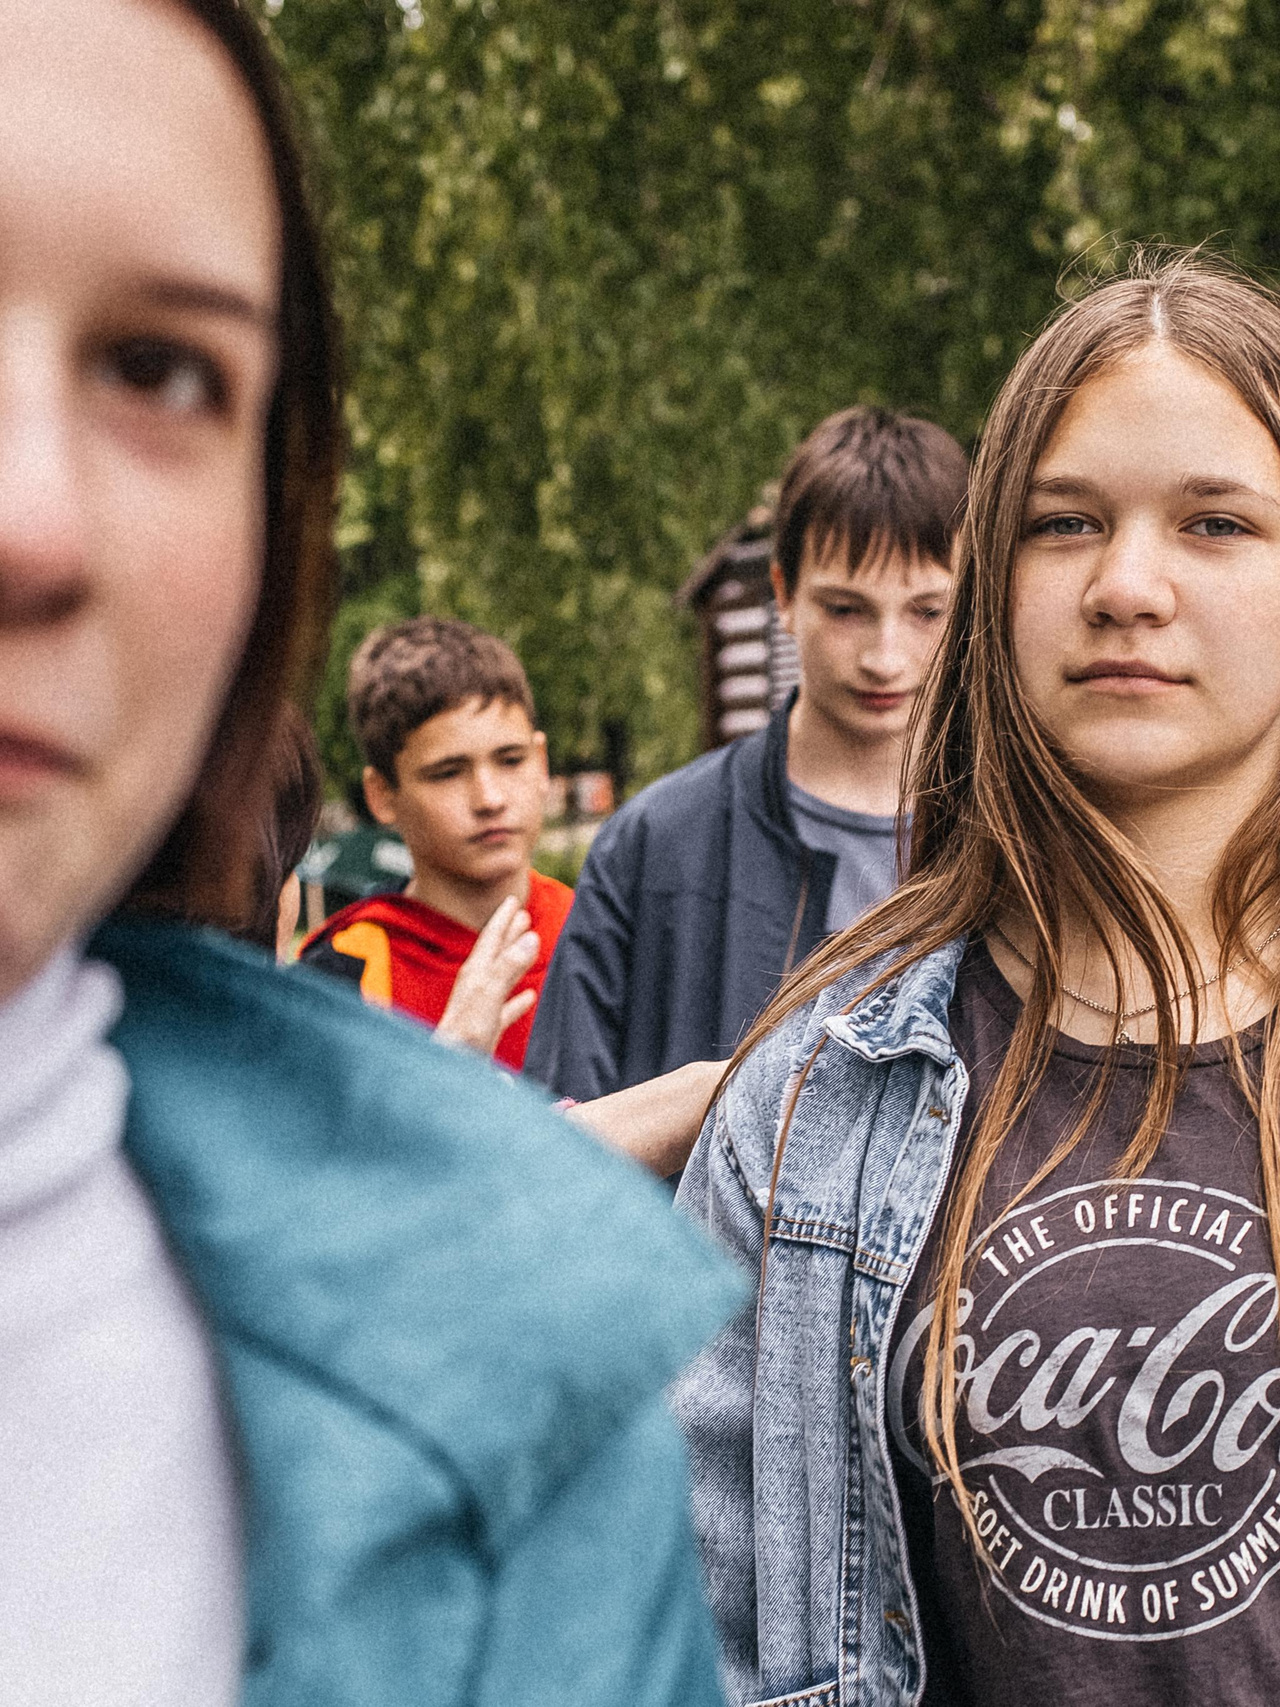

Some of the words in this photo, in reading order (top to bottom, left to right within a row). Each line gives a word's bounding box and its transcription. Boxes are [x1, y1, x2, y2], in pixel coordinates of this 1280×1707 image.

[981, 1215, 1056, 1277] THE
[1074, 1192, 1253, 1256] OFFICIAL
[1043, 1483, 1224, 1532] CLASSIC
[971, 1489, 1024, 1571] SOFT
[1020, 1555, 1128, 1624] DRINK
[1141, 1579, 1180, 1624] OF
